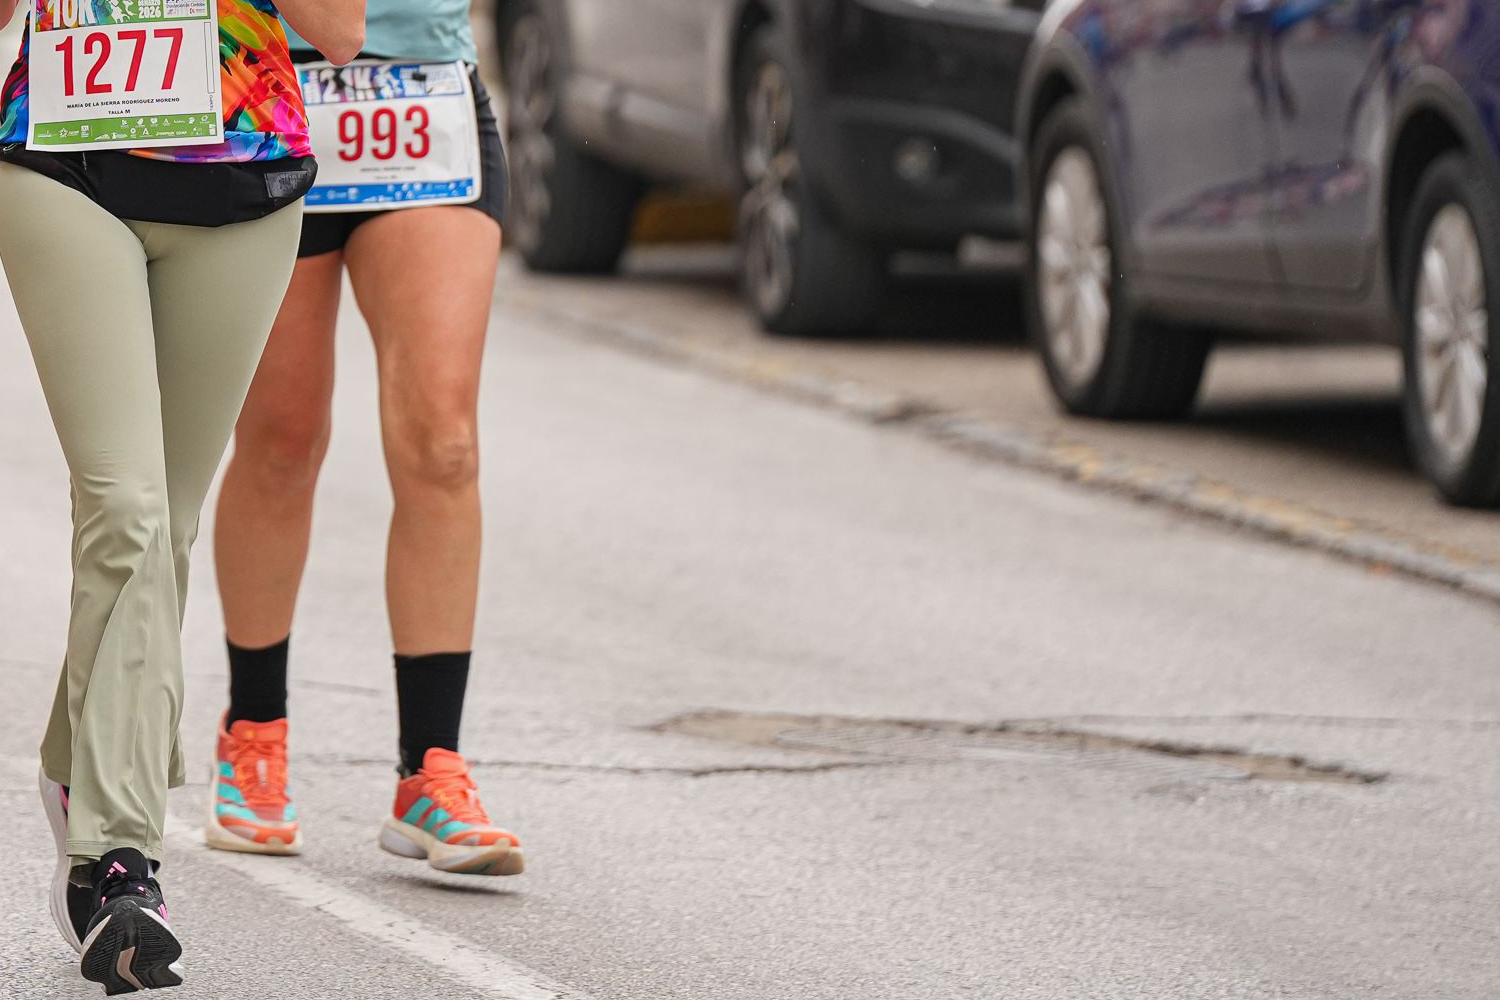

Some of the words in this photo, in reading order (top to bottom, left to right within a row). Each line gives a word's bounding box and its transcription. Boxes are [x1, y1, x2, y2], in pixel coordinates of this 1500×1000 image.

[138, 6, 161, 18] 2026
[55, 28, 183, 96] 1277
[338, 105, 430, 161] 993
